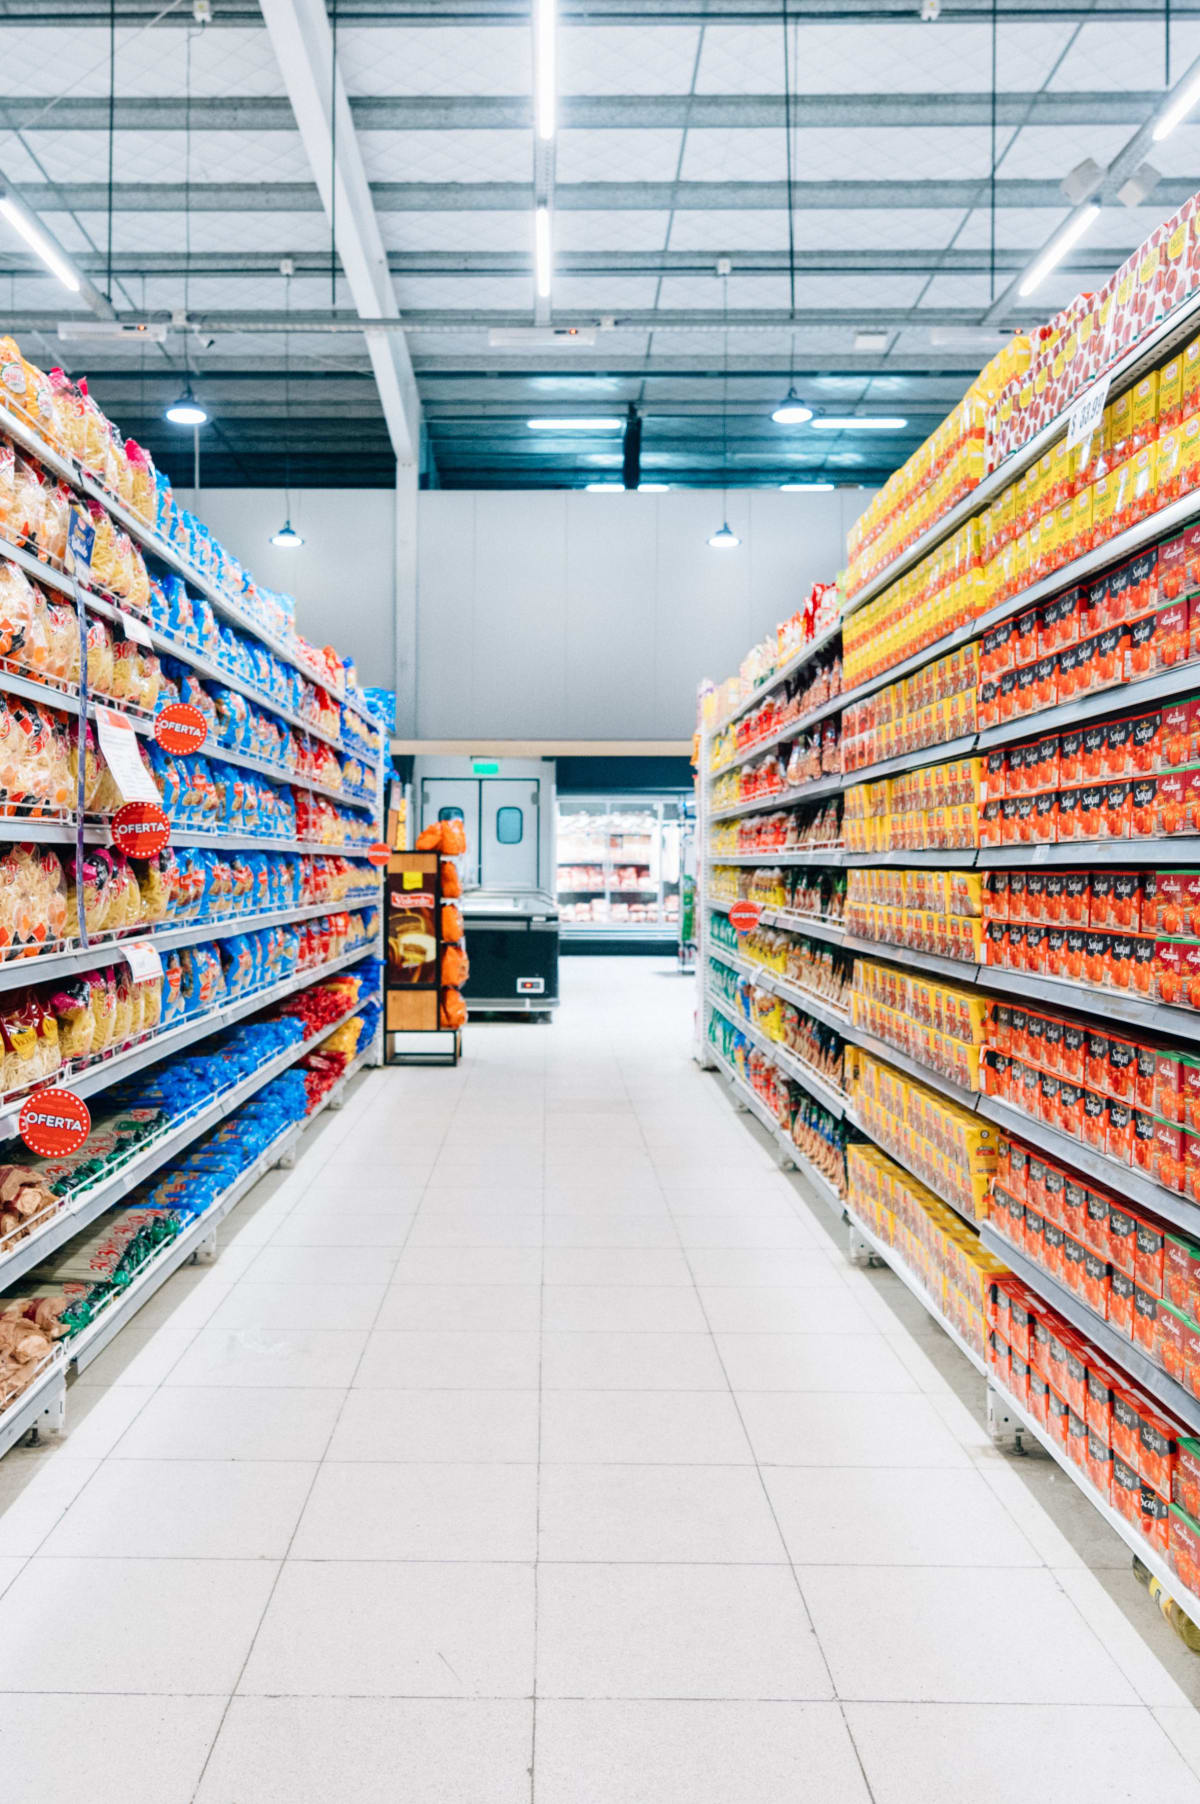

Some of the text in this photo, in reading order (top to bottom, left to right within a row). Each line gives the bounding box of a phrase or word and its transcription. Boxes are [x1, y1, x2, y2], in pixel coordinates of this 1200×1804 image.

[158, 719, 202, 737] OFERTA
[118, 821, 166, 836] OFERTA
[26, 1111, 83, 1132] OFERTA
